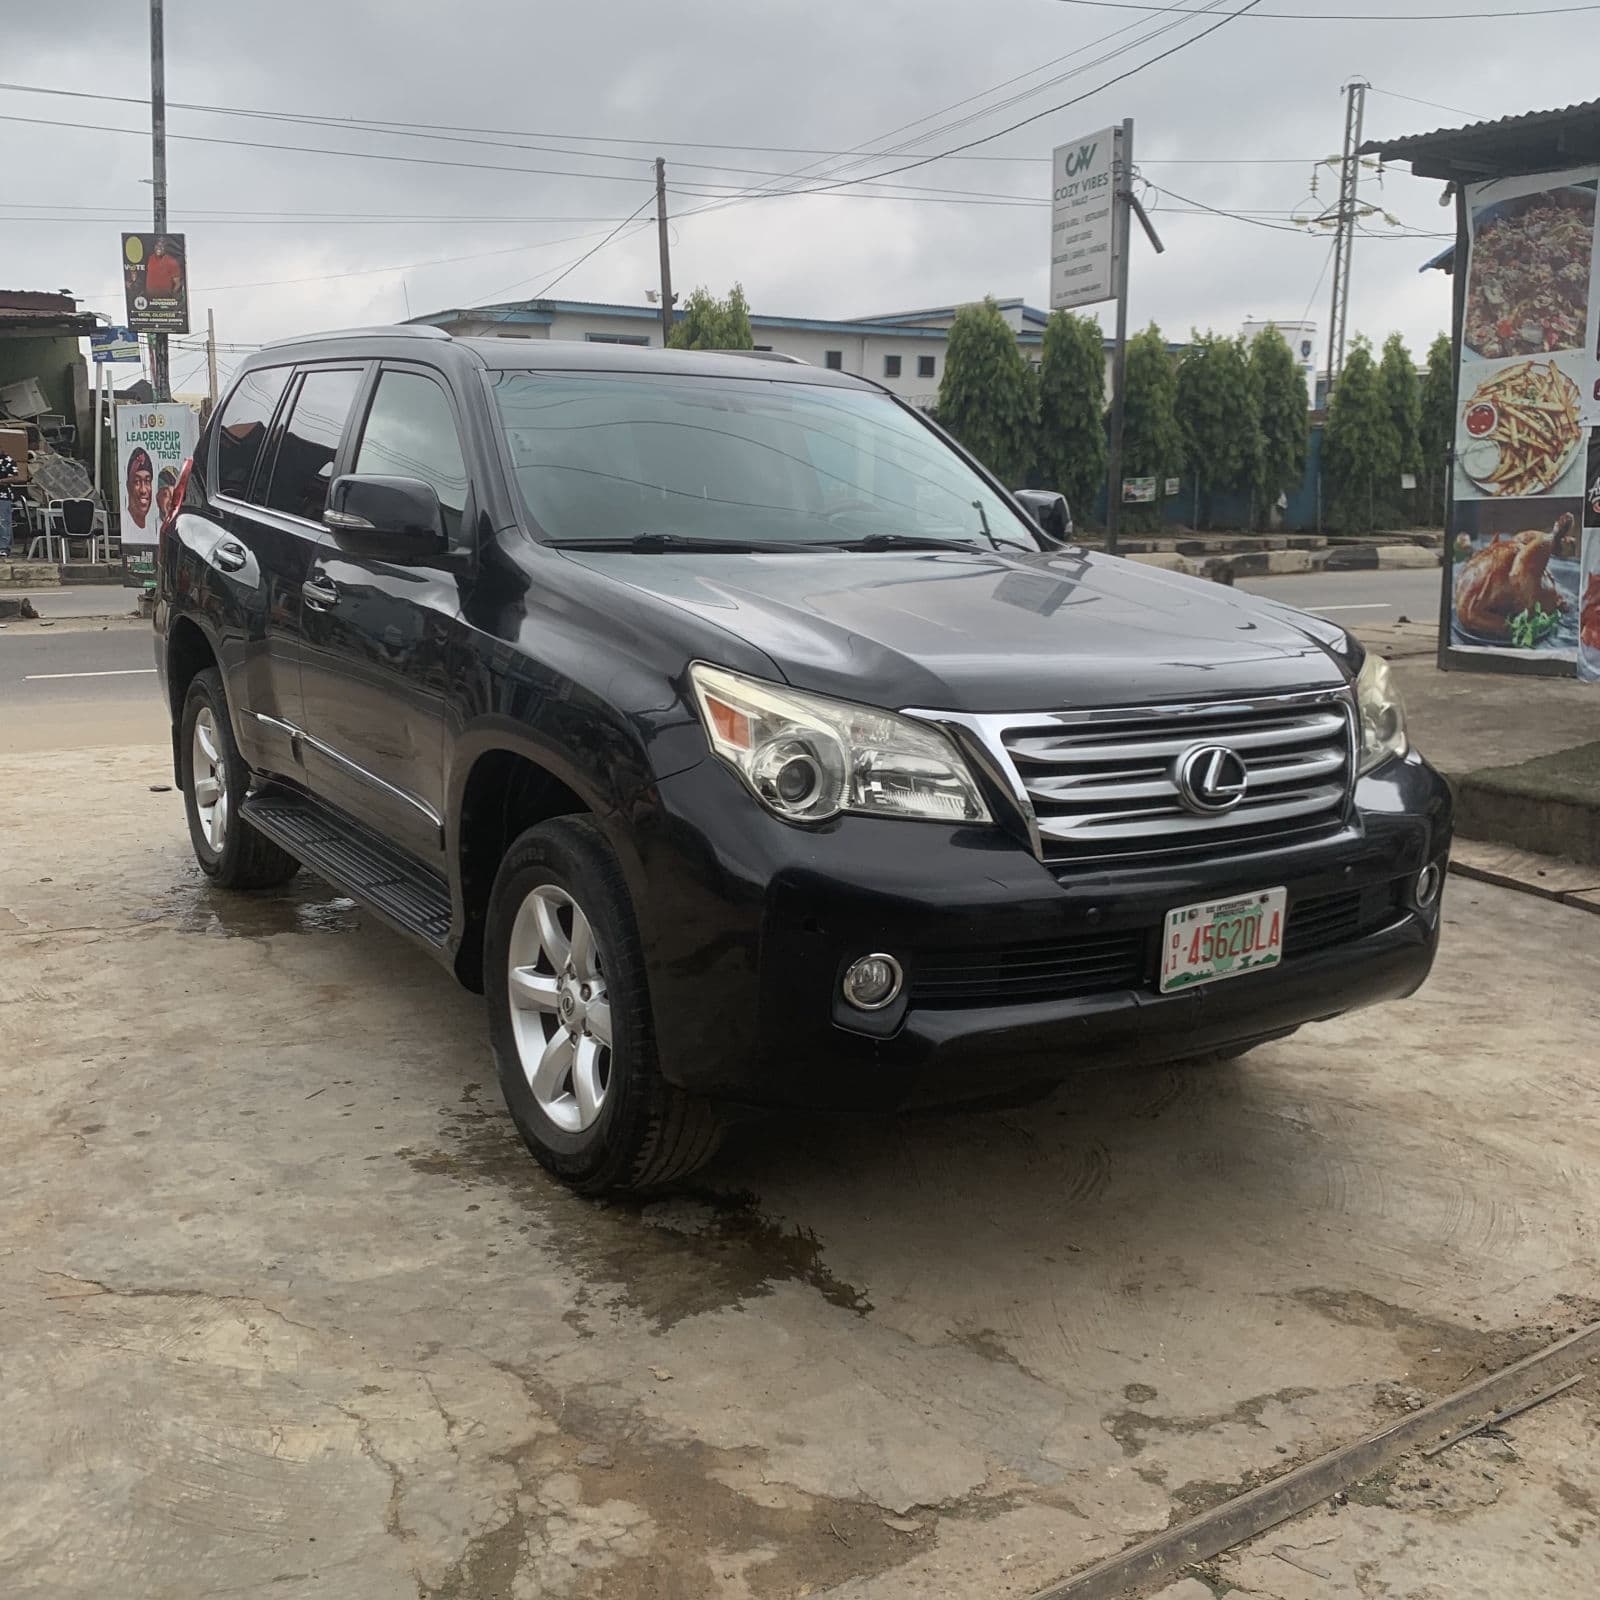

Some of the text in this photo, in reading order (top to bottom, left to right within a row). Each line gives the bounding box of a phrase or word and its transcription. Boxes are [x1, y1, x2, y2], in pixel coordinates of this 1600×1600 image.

[1054, 182, 1080, 201] COZY
[1082, 172, 1109, 192] VIBES
[126, 431, 180, 442] LEADERSHIP
[145, 441, 181, 450] YOU CAN
[157, 450, 181, 460] TRUST
